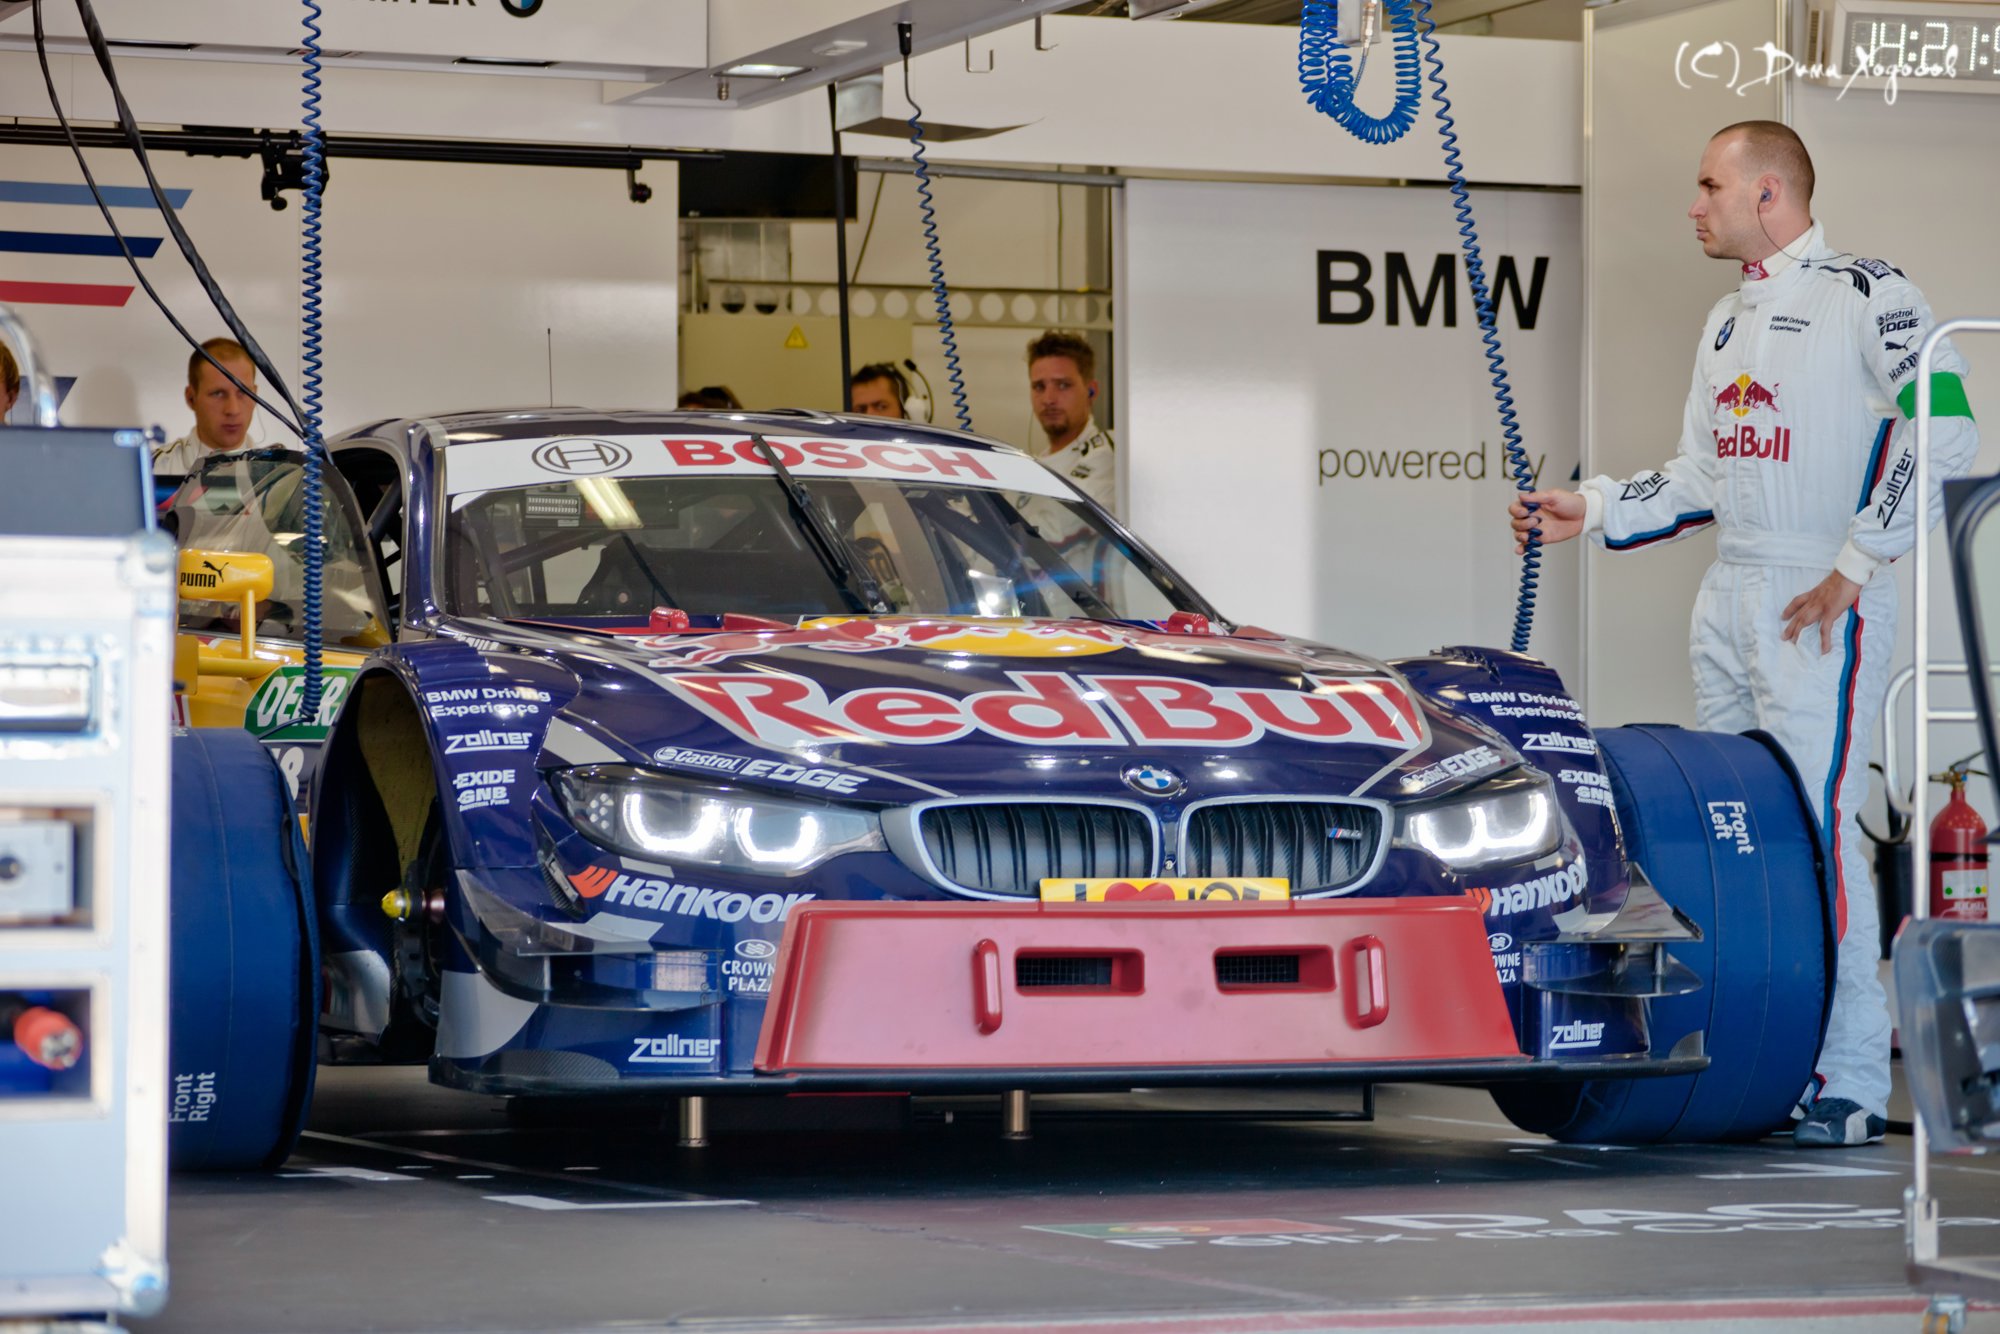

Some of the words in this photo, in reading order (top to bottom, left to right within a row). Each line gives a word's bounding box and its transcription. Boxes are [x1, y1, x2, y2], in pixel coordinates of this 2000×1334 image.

[1316, 249, 1549, 330] BMW
[1771, 315, 1789, 323] BMW
[1789, 316, 1811, 327] Driving
[1885, 308, 1914, 322] Castrol
[1769, 323, 1802, 333] Experience
[1880, 318, 1920, 337] EDGE
[1740, 425, 1790, 463] Bull
[661, 439, 998, 480] BOSCH
[1318, 441, 1486, 487] powered
[180, 572, 216, 588] PUMA
[426, 688, 478, 703] BMW
[482, 687, 551, 703] Driving
[1468, 691, 1516, 704] BMW
[1518, 692, 1581, 711] Driving
[430, 702, 539, 718] Experience
[1490, 704, 1587, 723] Experience
[1440, 745, 1501, 777] EDGE
[453, 769, 516, 790] EXIDE
[674, 749, 741, 771] Castrol
[739, 758, 870, 795] EDGE
[1557, 769, 1609, 790] EXIDE
[457, 786, 508, 805] GNB
[1707, 801, 1733, 840] Left
[1726, 801, 1755, 855] Front
[721, 960, 775, 976] CROWN
[728, 976, 772, 992] PLAZ
[169, 1073, 194, 1122] Front
[188, 1071, 217, 1122] Right
